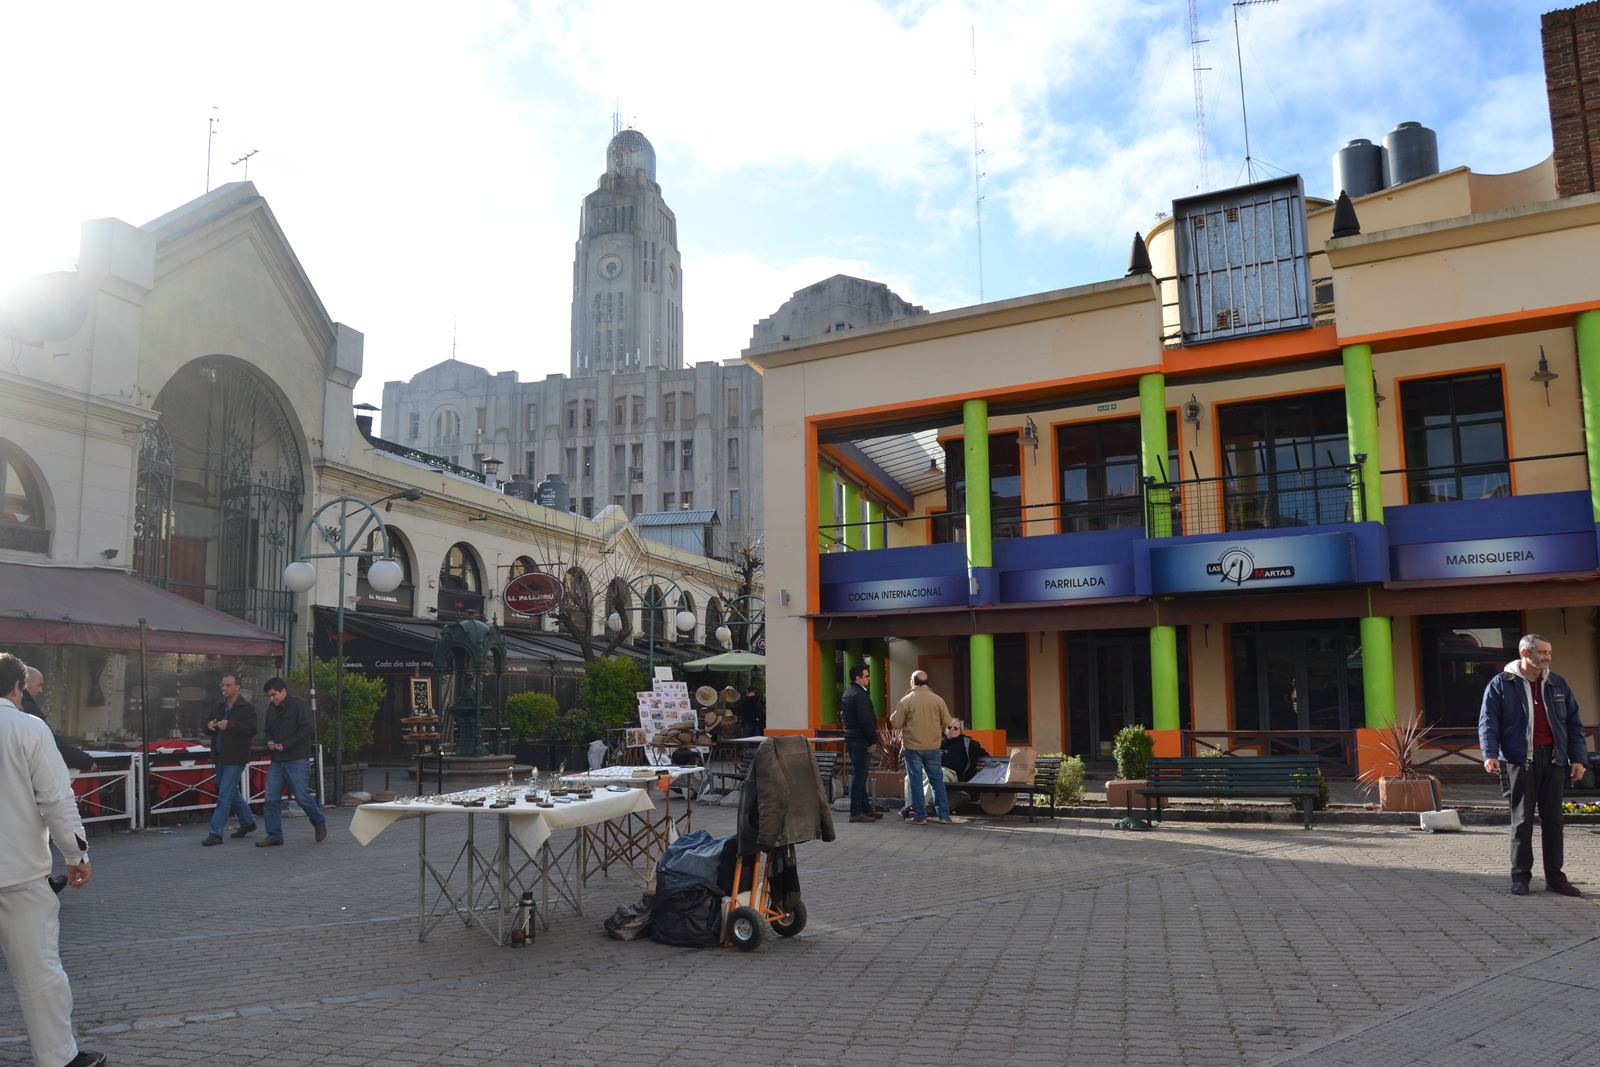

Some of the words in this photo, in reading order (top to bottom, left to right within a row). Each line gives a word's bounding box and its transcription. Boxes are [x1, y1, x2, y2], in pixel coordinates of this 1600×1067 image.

[1446, 550, 1535, 566] MARISQUERIA
[1208, 565, 1222, 573] LAS
[1044, 576, 1106, 589] PARRILLADA
[848, 592, 879, 602] COCINA
[881, 587, 943, 600] INTERNACIONAL
